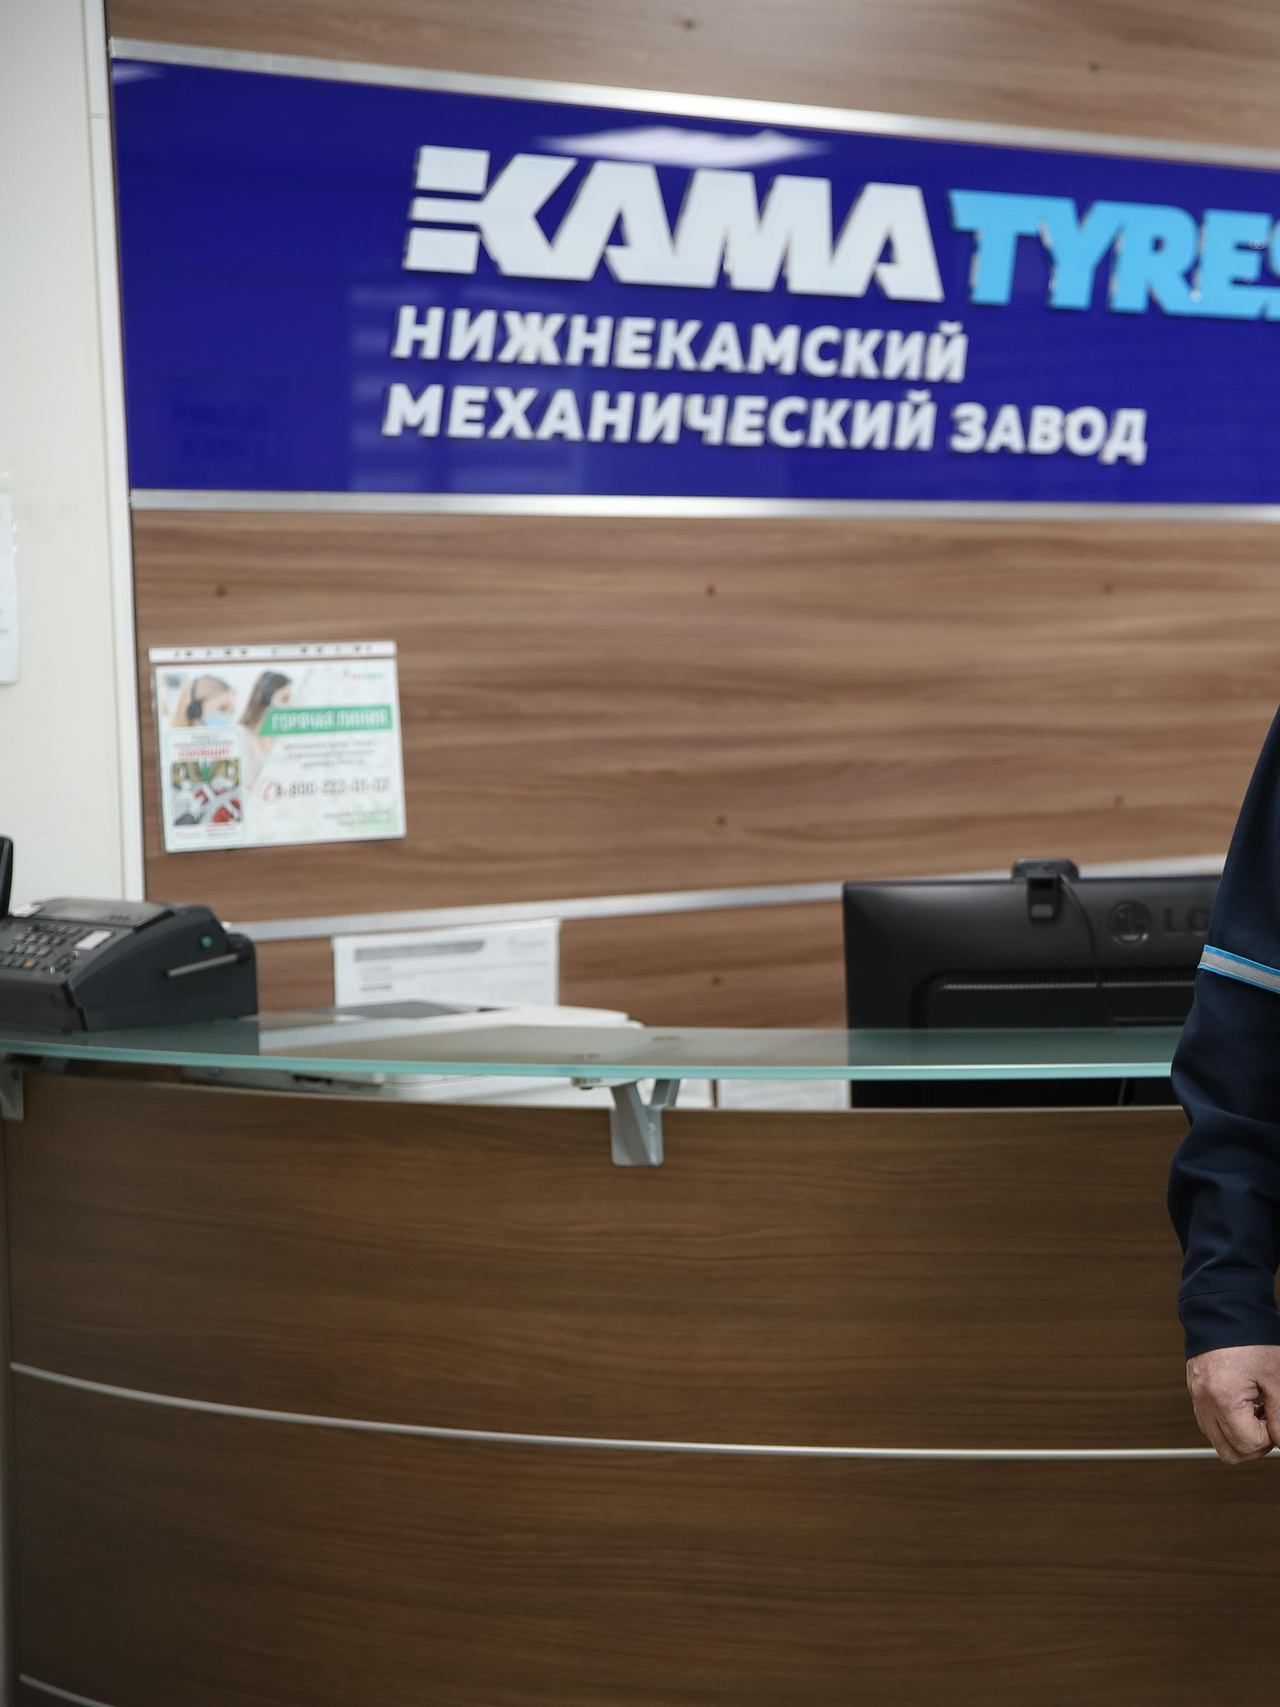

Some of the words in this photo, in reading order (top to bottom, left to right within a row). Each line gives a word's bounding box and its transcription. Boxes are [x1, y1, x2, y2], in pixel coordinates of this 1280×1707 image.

[403, 145, 945, 302] KAMA
[390, 304, 969, 383] НИЖНЕКАМСКИЙ
[380, 382, 938, 451] МЕХАНИЧЕСКИЙ
[949, 402, 1147, 466] ЗАВОД
